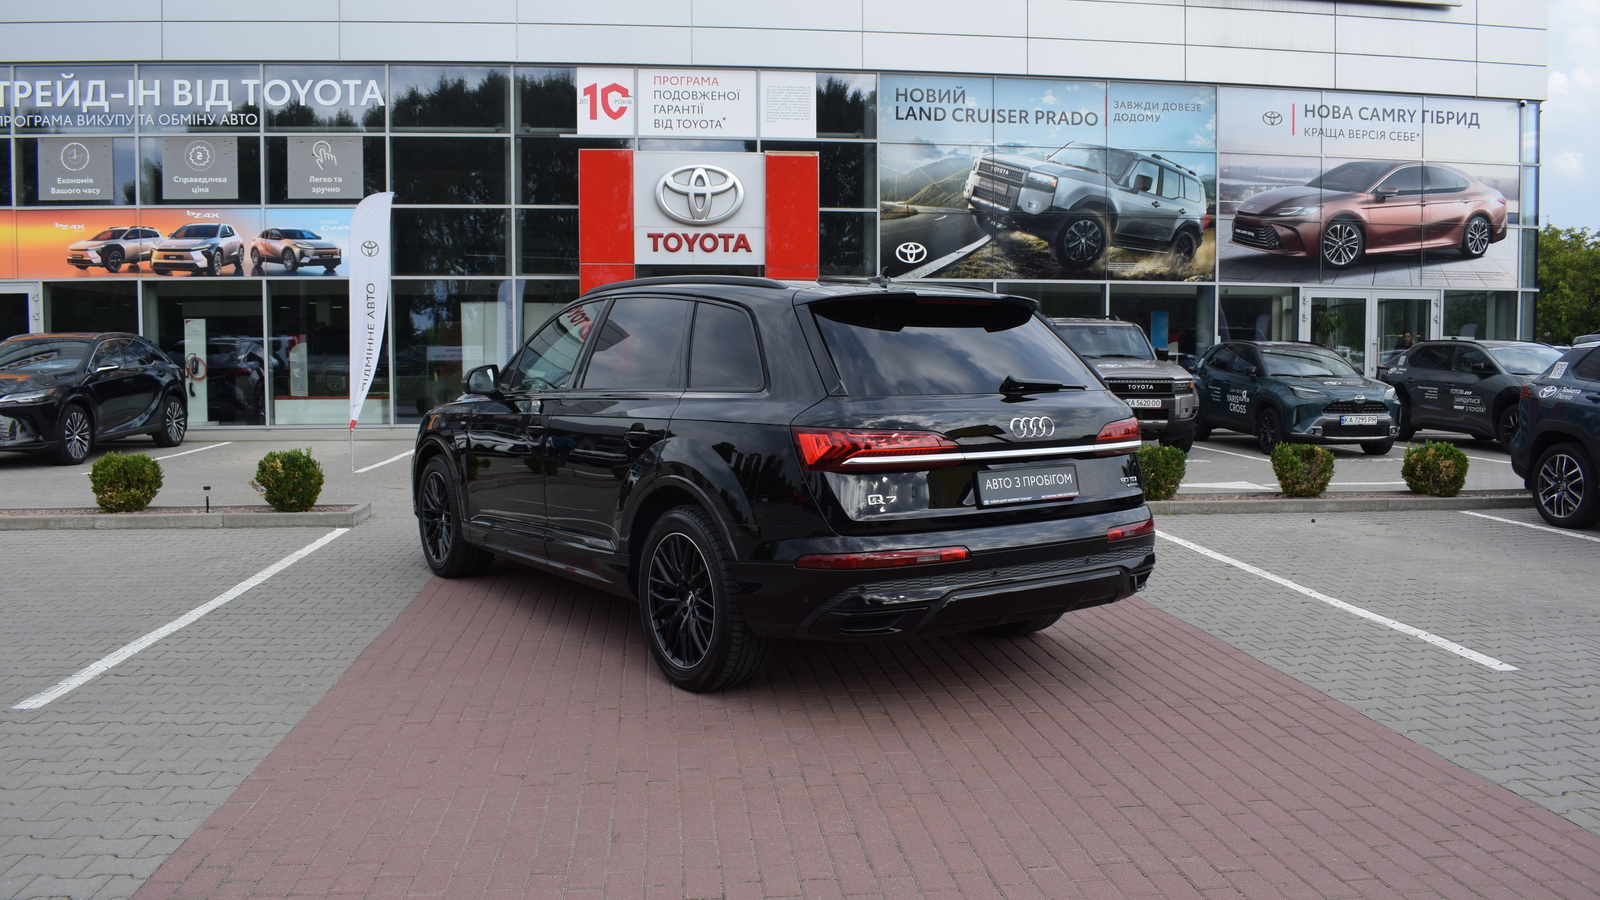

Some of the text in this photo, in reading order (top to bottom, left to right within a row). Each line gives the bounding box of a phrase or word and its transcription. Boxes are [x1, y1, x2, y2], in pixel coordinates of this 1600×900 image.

[653, 76, 719, 86] ПРОГРАМА
[0, 72, 385, 113] ТРЕЙД-ІН ВІД TOYOTA
[653, 89, 741, 101] ПОДОВЖЕНОЇ
[895, 86, 966, 104] НОВИЙ
[653, 103, 704, 114] ГАРАНТІЇ
[1113, 101, 1202, 112] ЗАВЖДИ ДОВЕЗЕ
[77, 114, 135, 126] ВИКУПУ
[139, 114, 155, 126] ТА
[158, 114, 217, 126] ОБМІНУ
[220, 113, 258, 126] АВТО
[895, 106, 1099, 126] LAND CRUISER PRADO
[1113, 113, 1161, 123] ДОДОМУ
[1304, 104, 1480, 129] НОВА CAMRY ГІБРИД
[653, 119, 673, 130] ВІД
[1304, 127, 1345, 139] КРАЩА
[1348, 129, 1386, 140] ВЕРСІЯ
[173, 176, 227, 184] Справедлива
[647, 232, 752, 253] TOYOTA
[366, 282, 376, 319] АВТО
[1229, 403, 1247, 414] CROSS
[985, 477, 1012, 490] АВТО
[1023, 473, 1073, 487] ПРОБІГОМ
[868, 494, 897, 505] Q7
